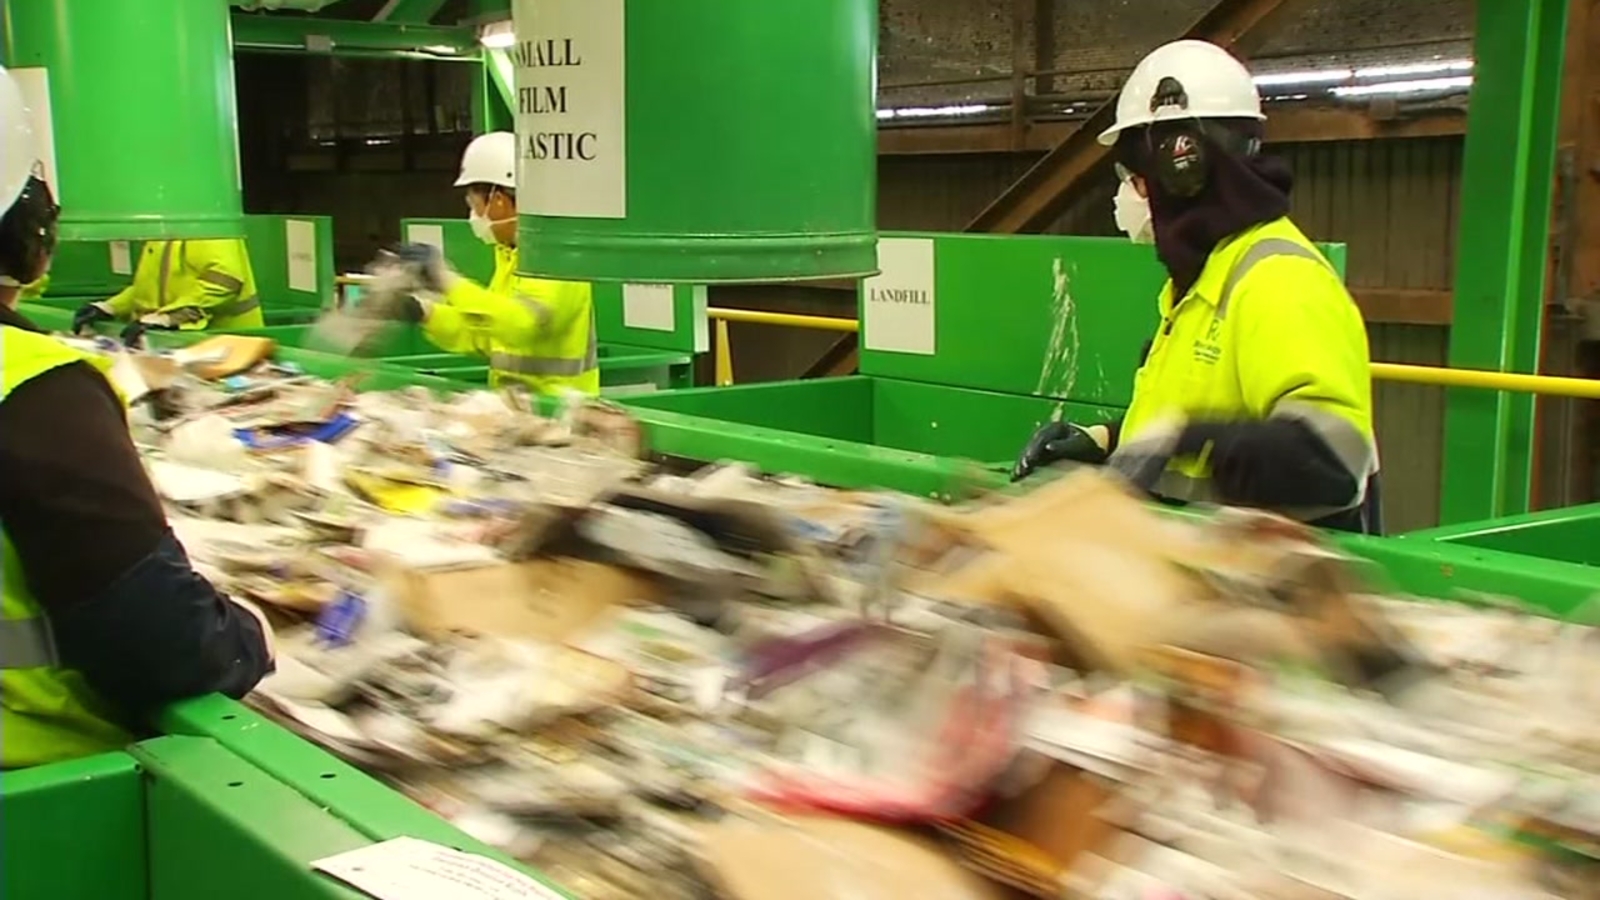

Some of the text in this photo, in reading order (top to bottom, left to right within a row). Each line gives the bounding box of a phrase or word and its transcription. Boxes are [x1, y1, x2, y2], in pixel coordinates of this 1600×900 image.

[519, 86, 567, 114] FILM
[523, 132, 598, 161] ASTIC
[870, 288, 931, 305] LANDFILL
